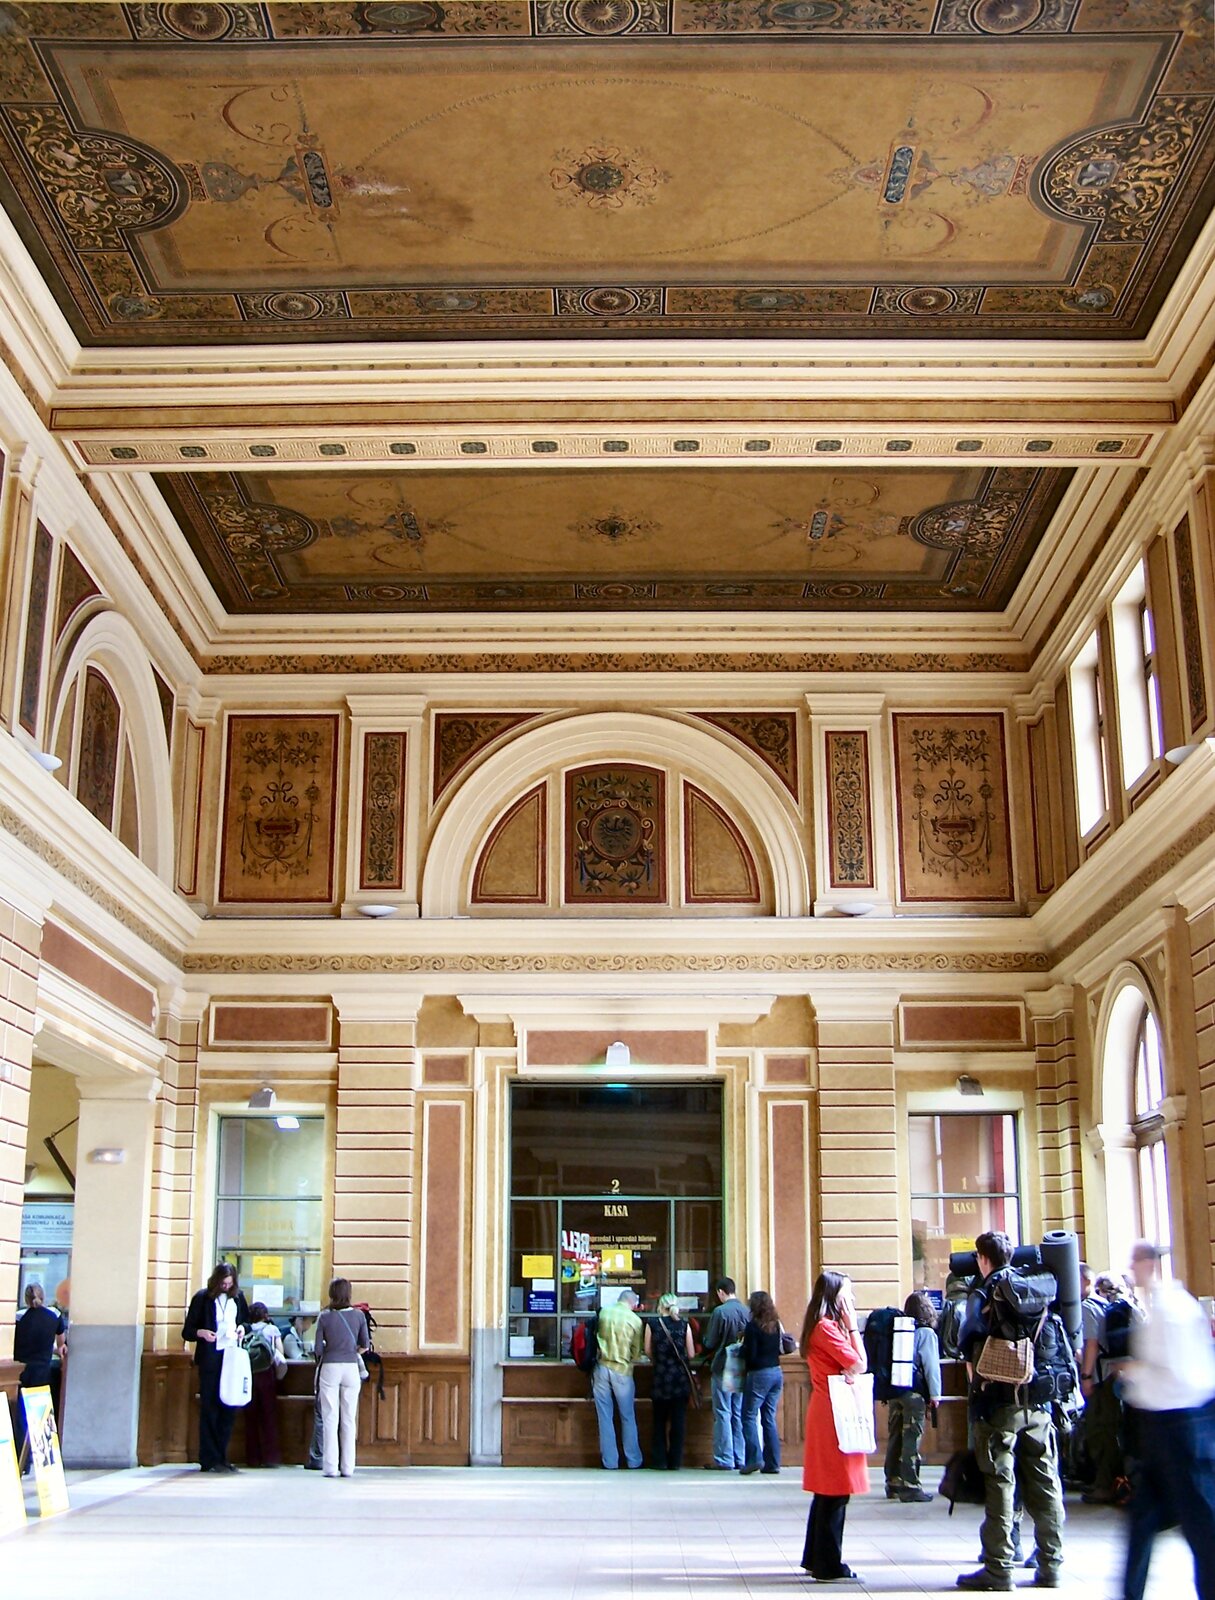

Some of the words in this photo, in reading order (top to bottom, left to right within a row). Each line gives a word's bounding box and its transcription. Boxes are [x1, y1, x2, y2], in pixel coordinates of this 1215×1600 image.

[611, 1179, 620, 1192] 2
[962, 1176, 967, 1190] 1
[604, 1204, 628, 1216] KASA
[952, 1200, 977, 1214] KASA
